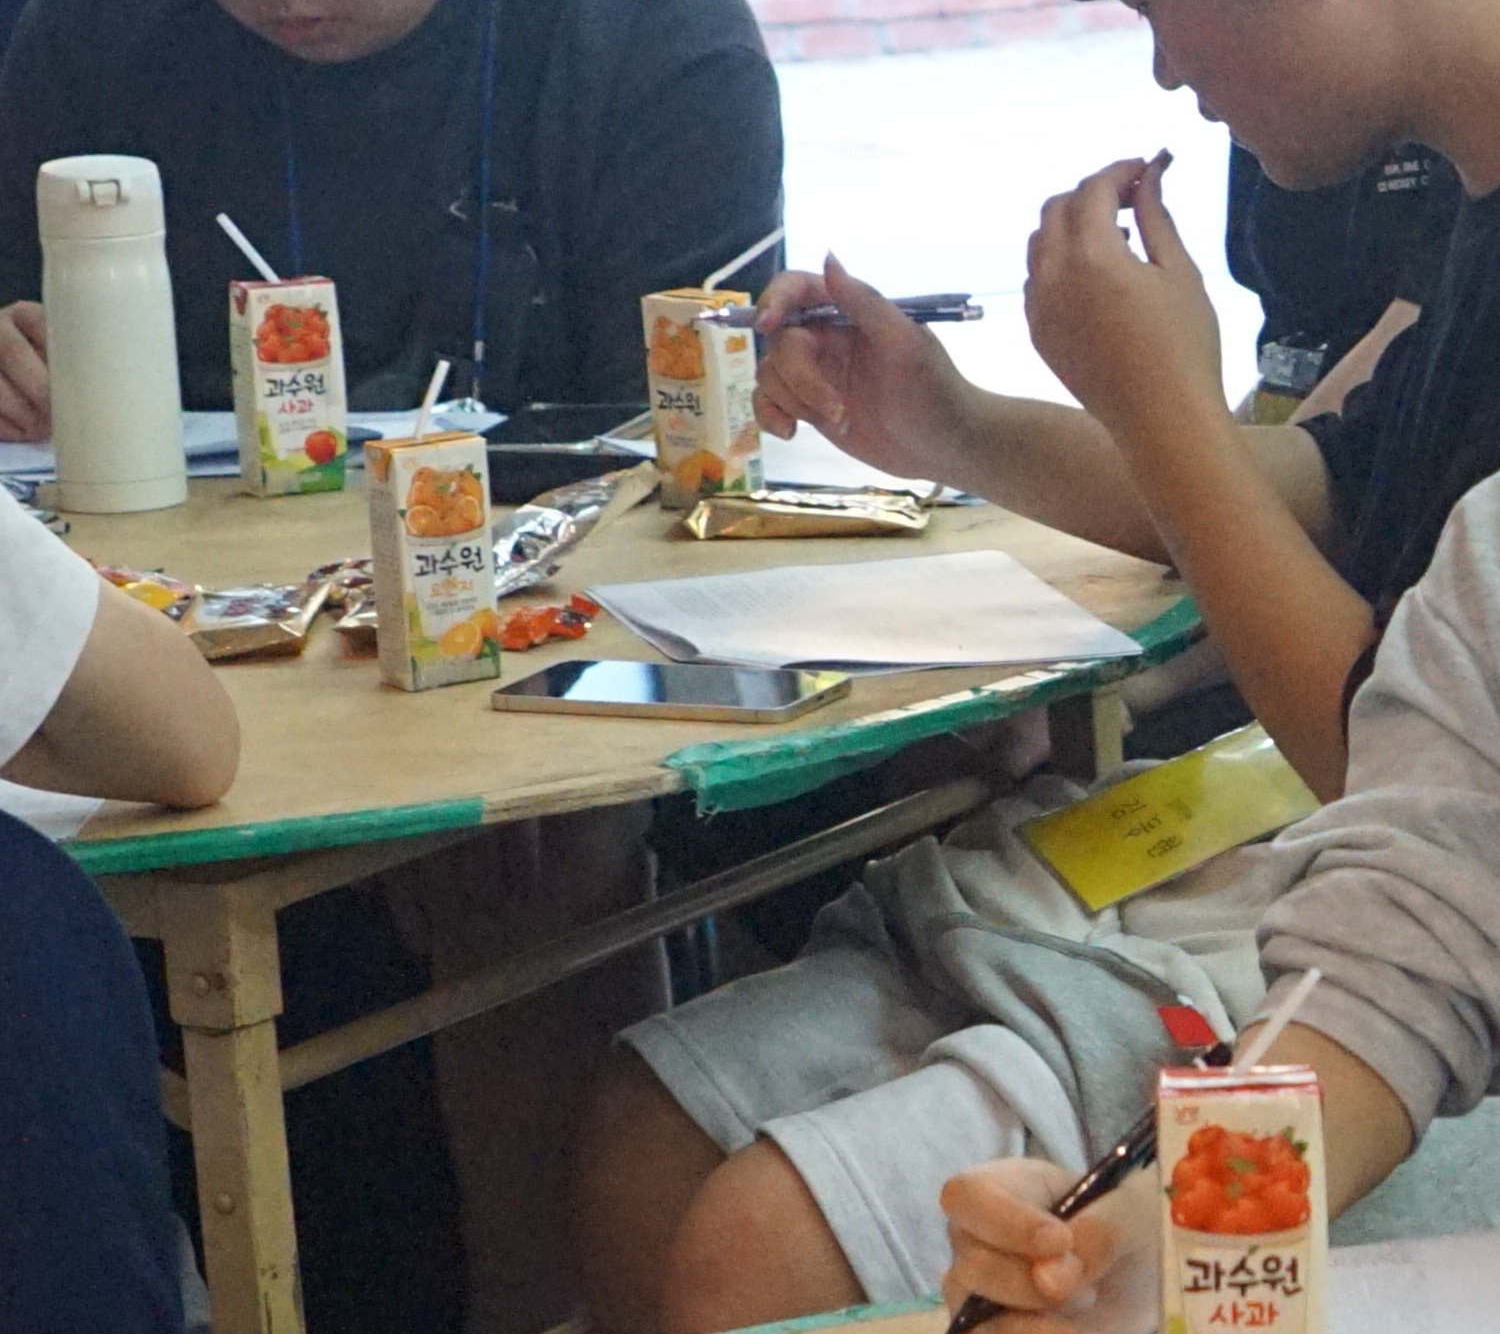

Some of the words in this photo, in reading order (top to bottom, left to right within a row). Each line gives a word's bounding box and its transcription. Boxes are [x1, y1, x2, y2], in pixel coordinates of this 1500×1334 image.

[263, 371, 328, 398] 과수원
[276, 398, 315, 415] 사과
[414, 545, 485, 577] 과수원
[1183, 1253, 1304, 1299] 과수원
[1207, 1299, 1281, 1328] 사과
